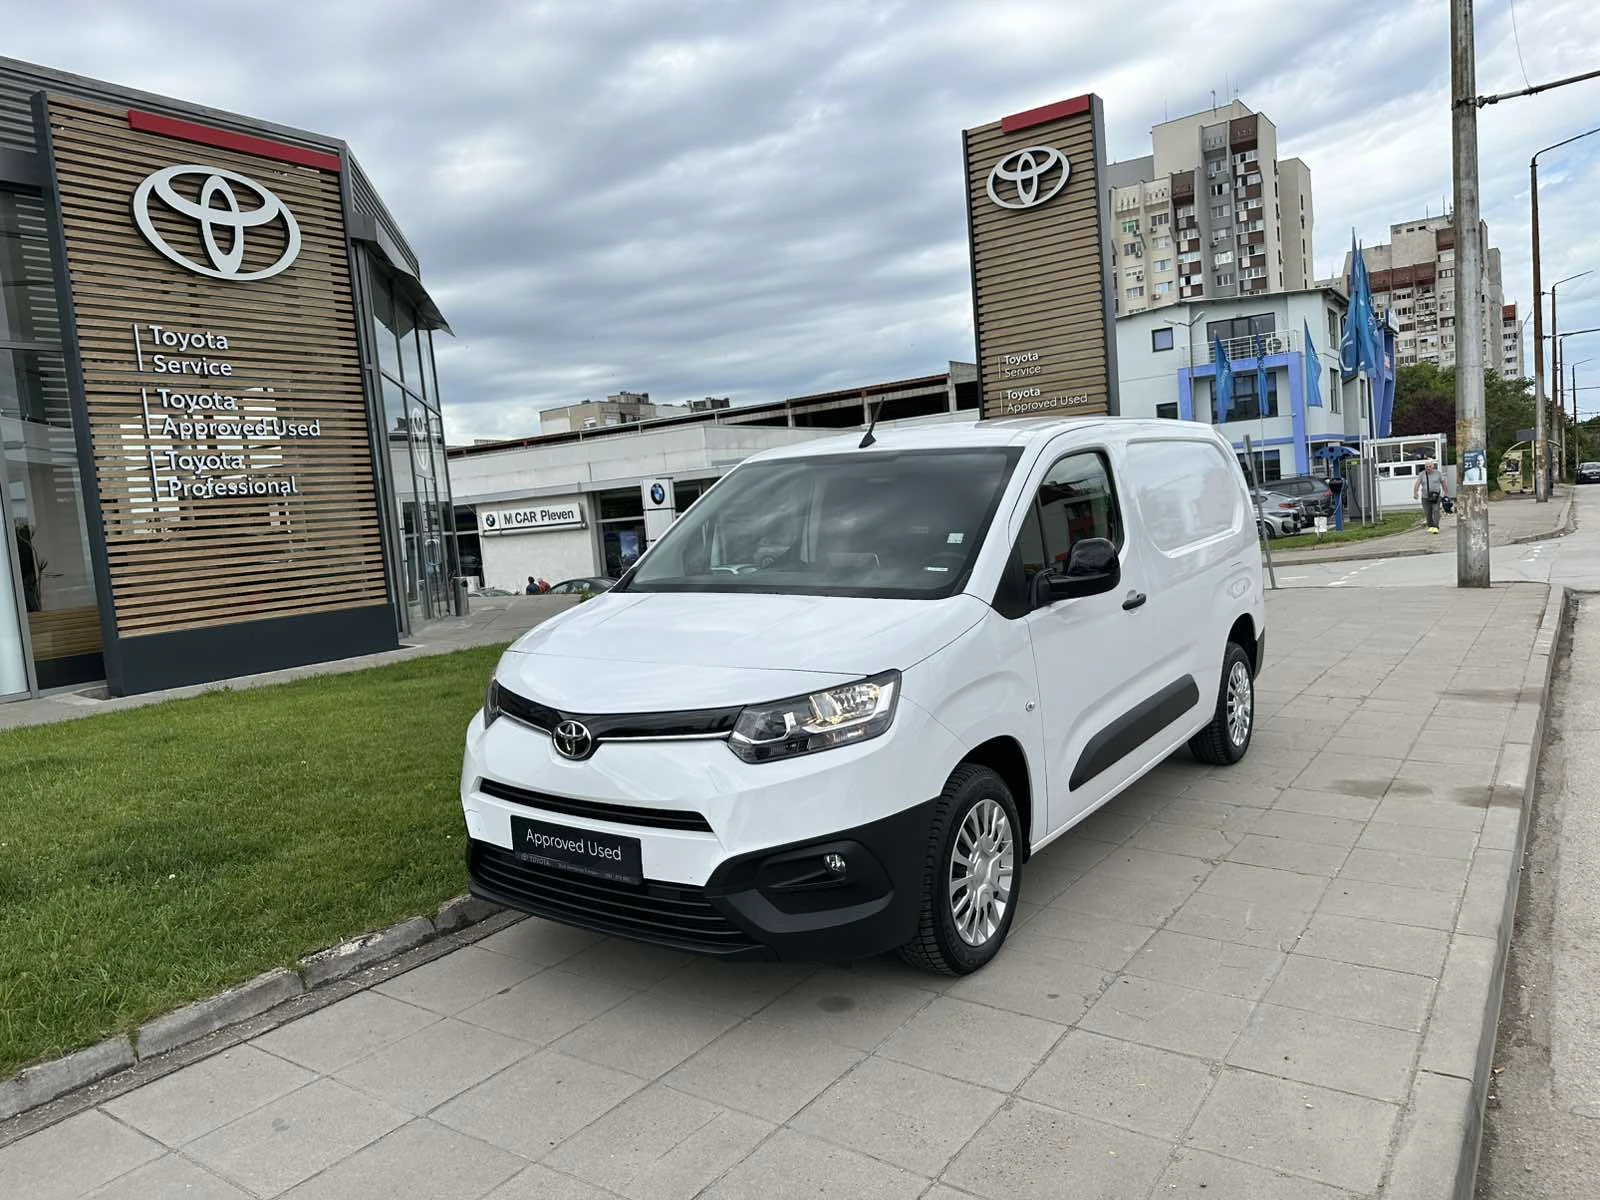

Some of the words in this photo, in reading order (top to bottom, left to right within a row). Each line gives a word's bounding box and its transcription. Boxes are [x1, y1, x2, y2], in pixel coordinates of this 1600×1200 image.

[149, 325, 229, 351] Toyota
[152, 355, 232, 376] Service
[1004, 351, 1039, 365] Toyota
[1004, 365, 1041, 378] Service
[156, 388, 236, 413] Toyota
[1006, 386, 1040, 400] Toyota
[1006, 397, 1057, 413] Approved
[1060, 392, 1088, 405] Used
[162, 418, 267, 440] Approved
[272, 419, 320, 437] Used
[165, 451, 244, 474] Toyota
[168, 475, 298, 498] Professional
[503, 513, 513, 525] M
[515, 510, 537, 523] CAR
[540, 508, 574, 521] Pleven
[526, 828, 584, 853] Approved
[588, 840, 622, 860] Used
